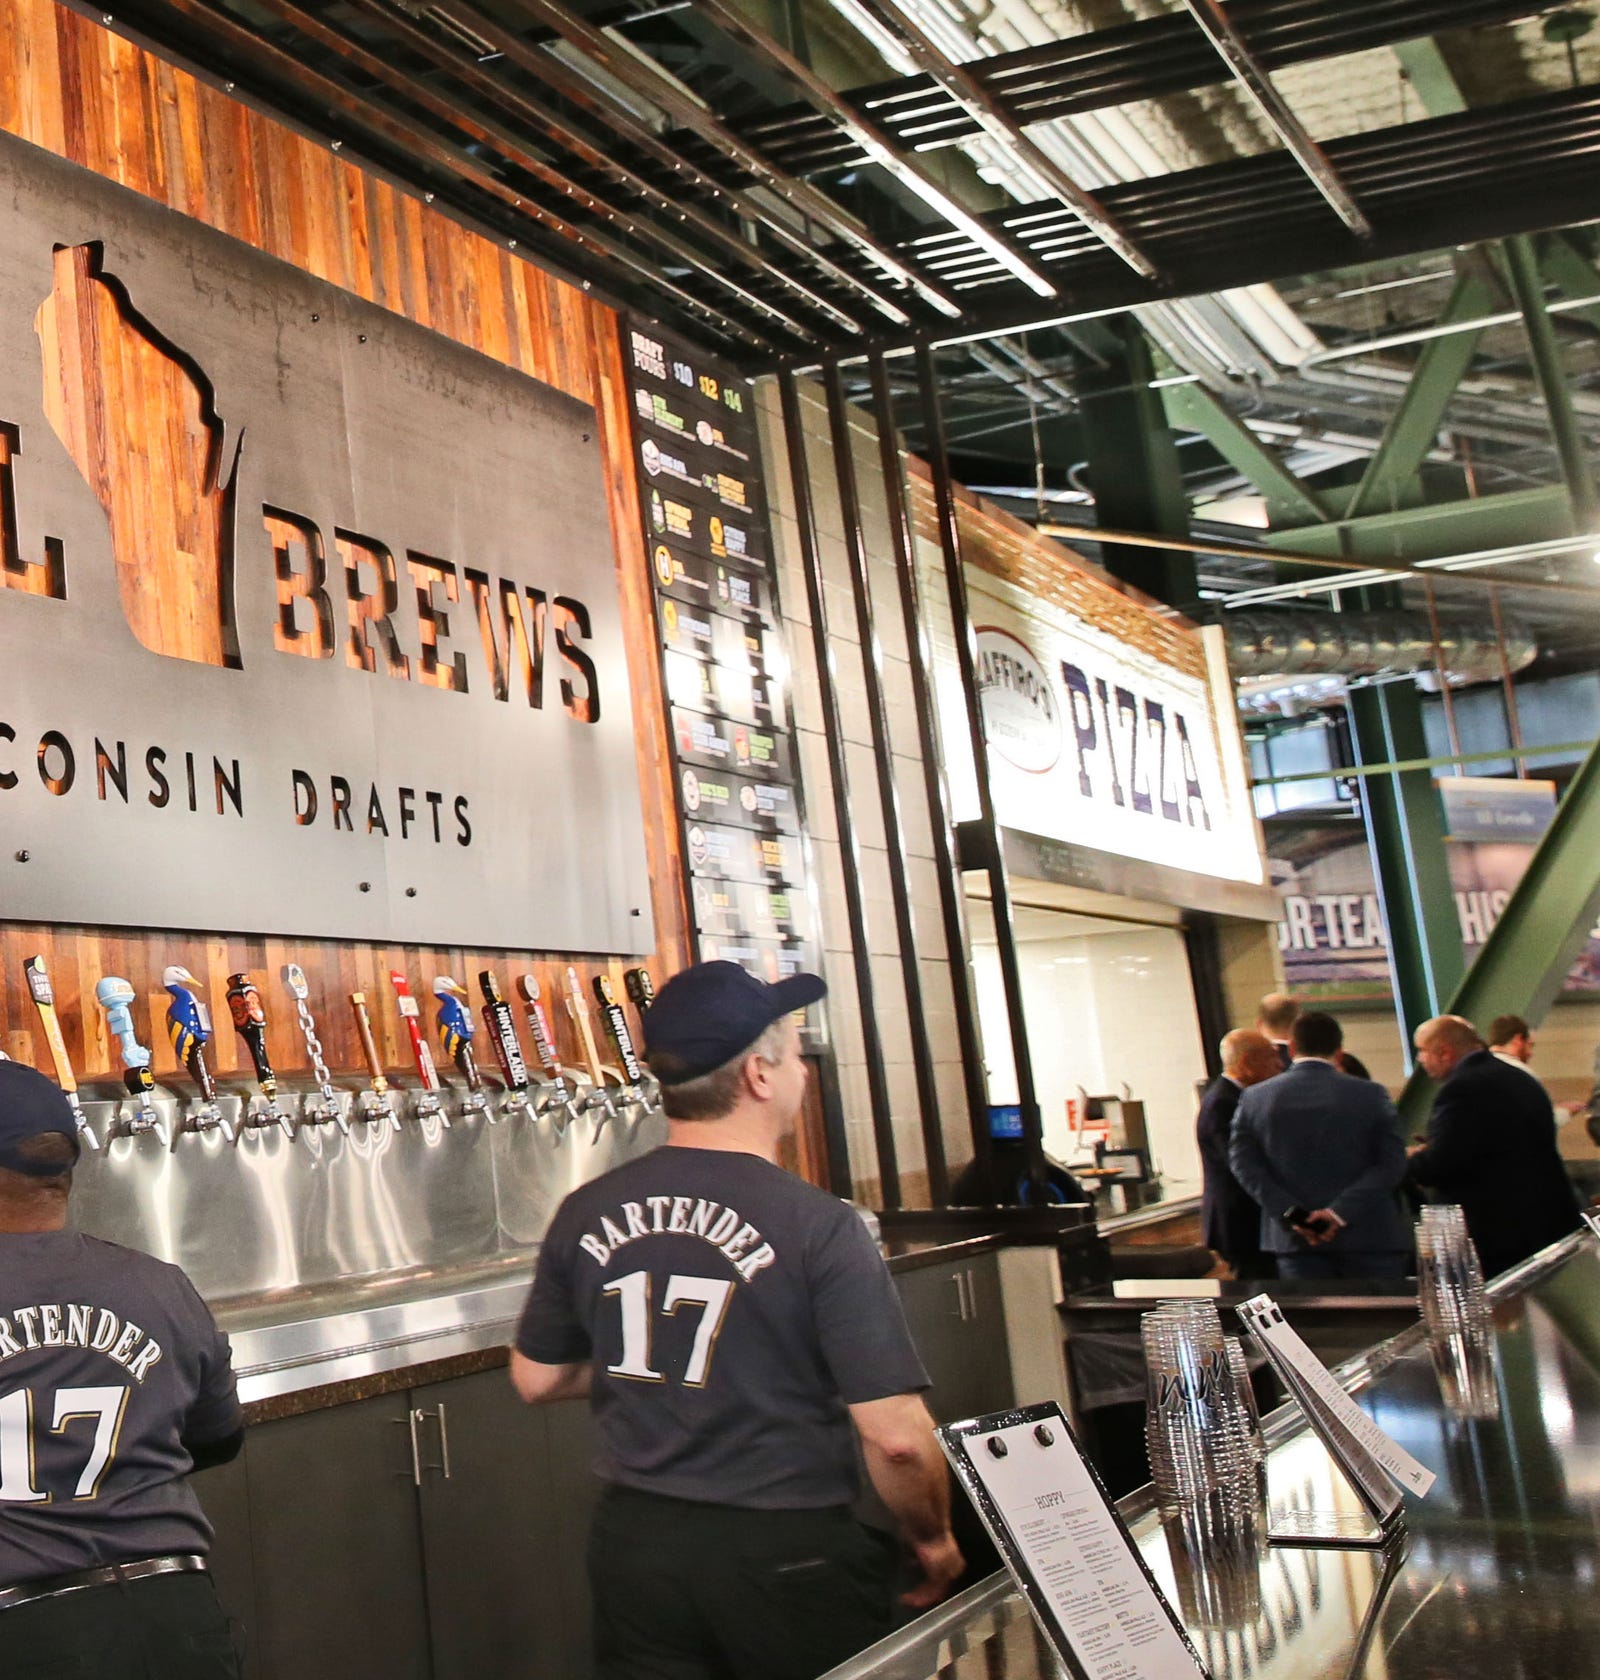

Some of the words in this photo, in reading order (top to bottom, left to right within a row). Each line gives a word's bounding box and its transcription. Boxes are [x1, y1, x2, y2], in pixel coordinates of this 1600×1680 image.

[699, 375, 719, 401] $12
[260, 502, 601, 725] BREWS
[1061, 660, 1212, 832] PIZZA
[292, 768, 474, 849] DRAFTS
[496, 1006, 526, 1086] HINTERLAND
[610, 1008, 640, 1080] HINTERLAND
[579, 1196, 776, 1283] BARTENDER
[603, 1270, 736, 1389] 17
[1035, 1491, 1065, 1509] HOPPY
